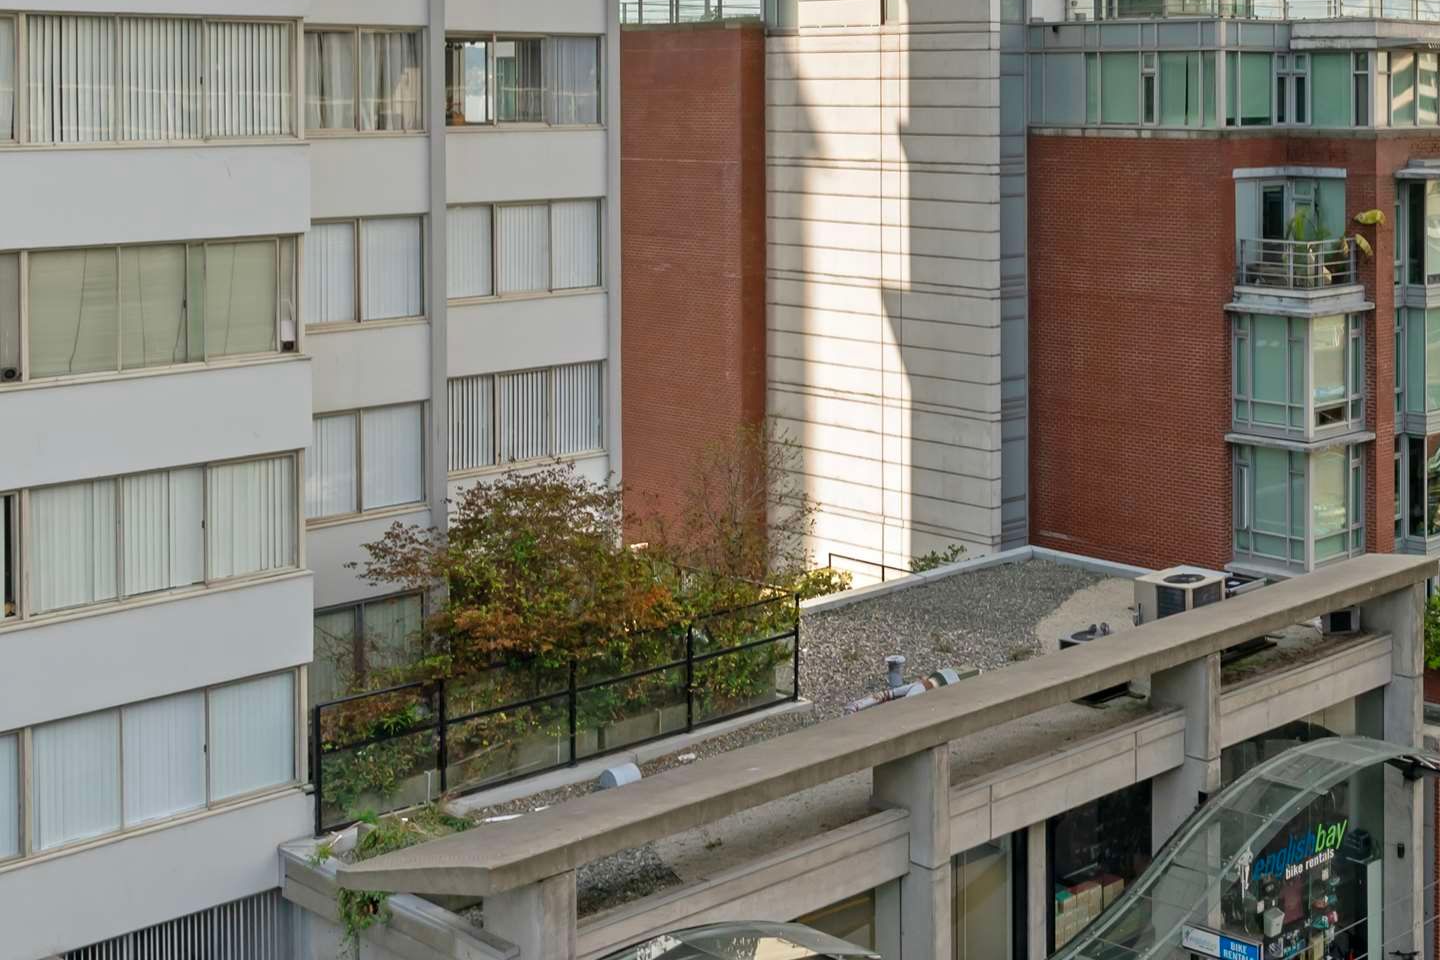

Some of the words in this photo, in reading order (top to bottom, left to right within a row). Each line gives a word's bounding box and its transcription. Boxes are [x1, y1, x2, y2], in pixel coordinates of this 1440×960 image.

[1285, 863, 1304, 881] bike
[1305, 848, 1335, 871] rentals
[1230, 941, 1249, 954] BIKE
